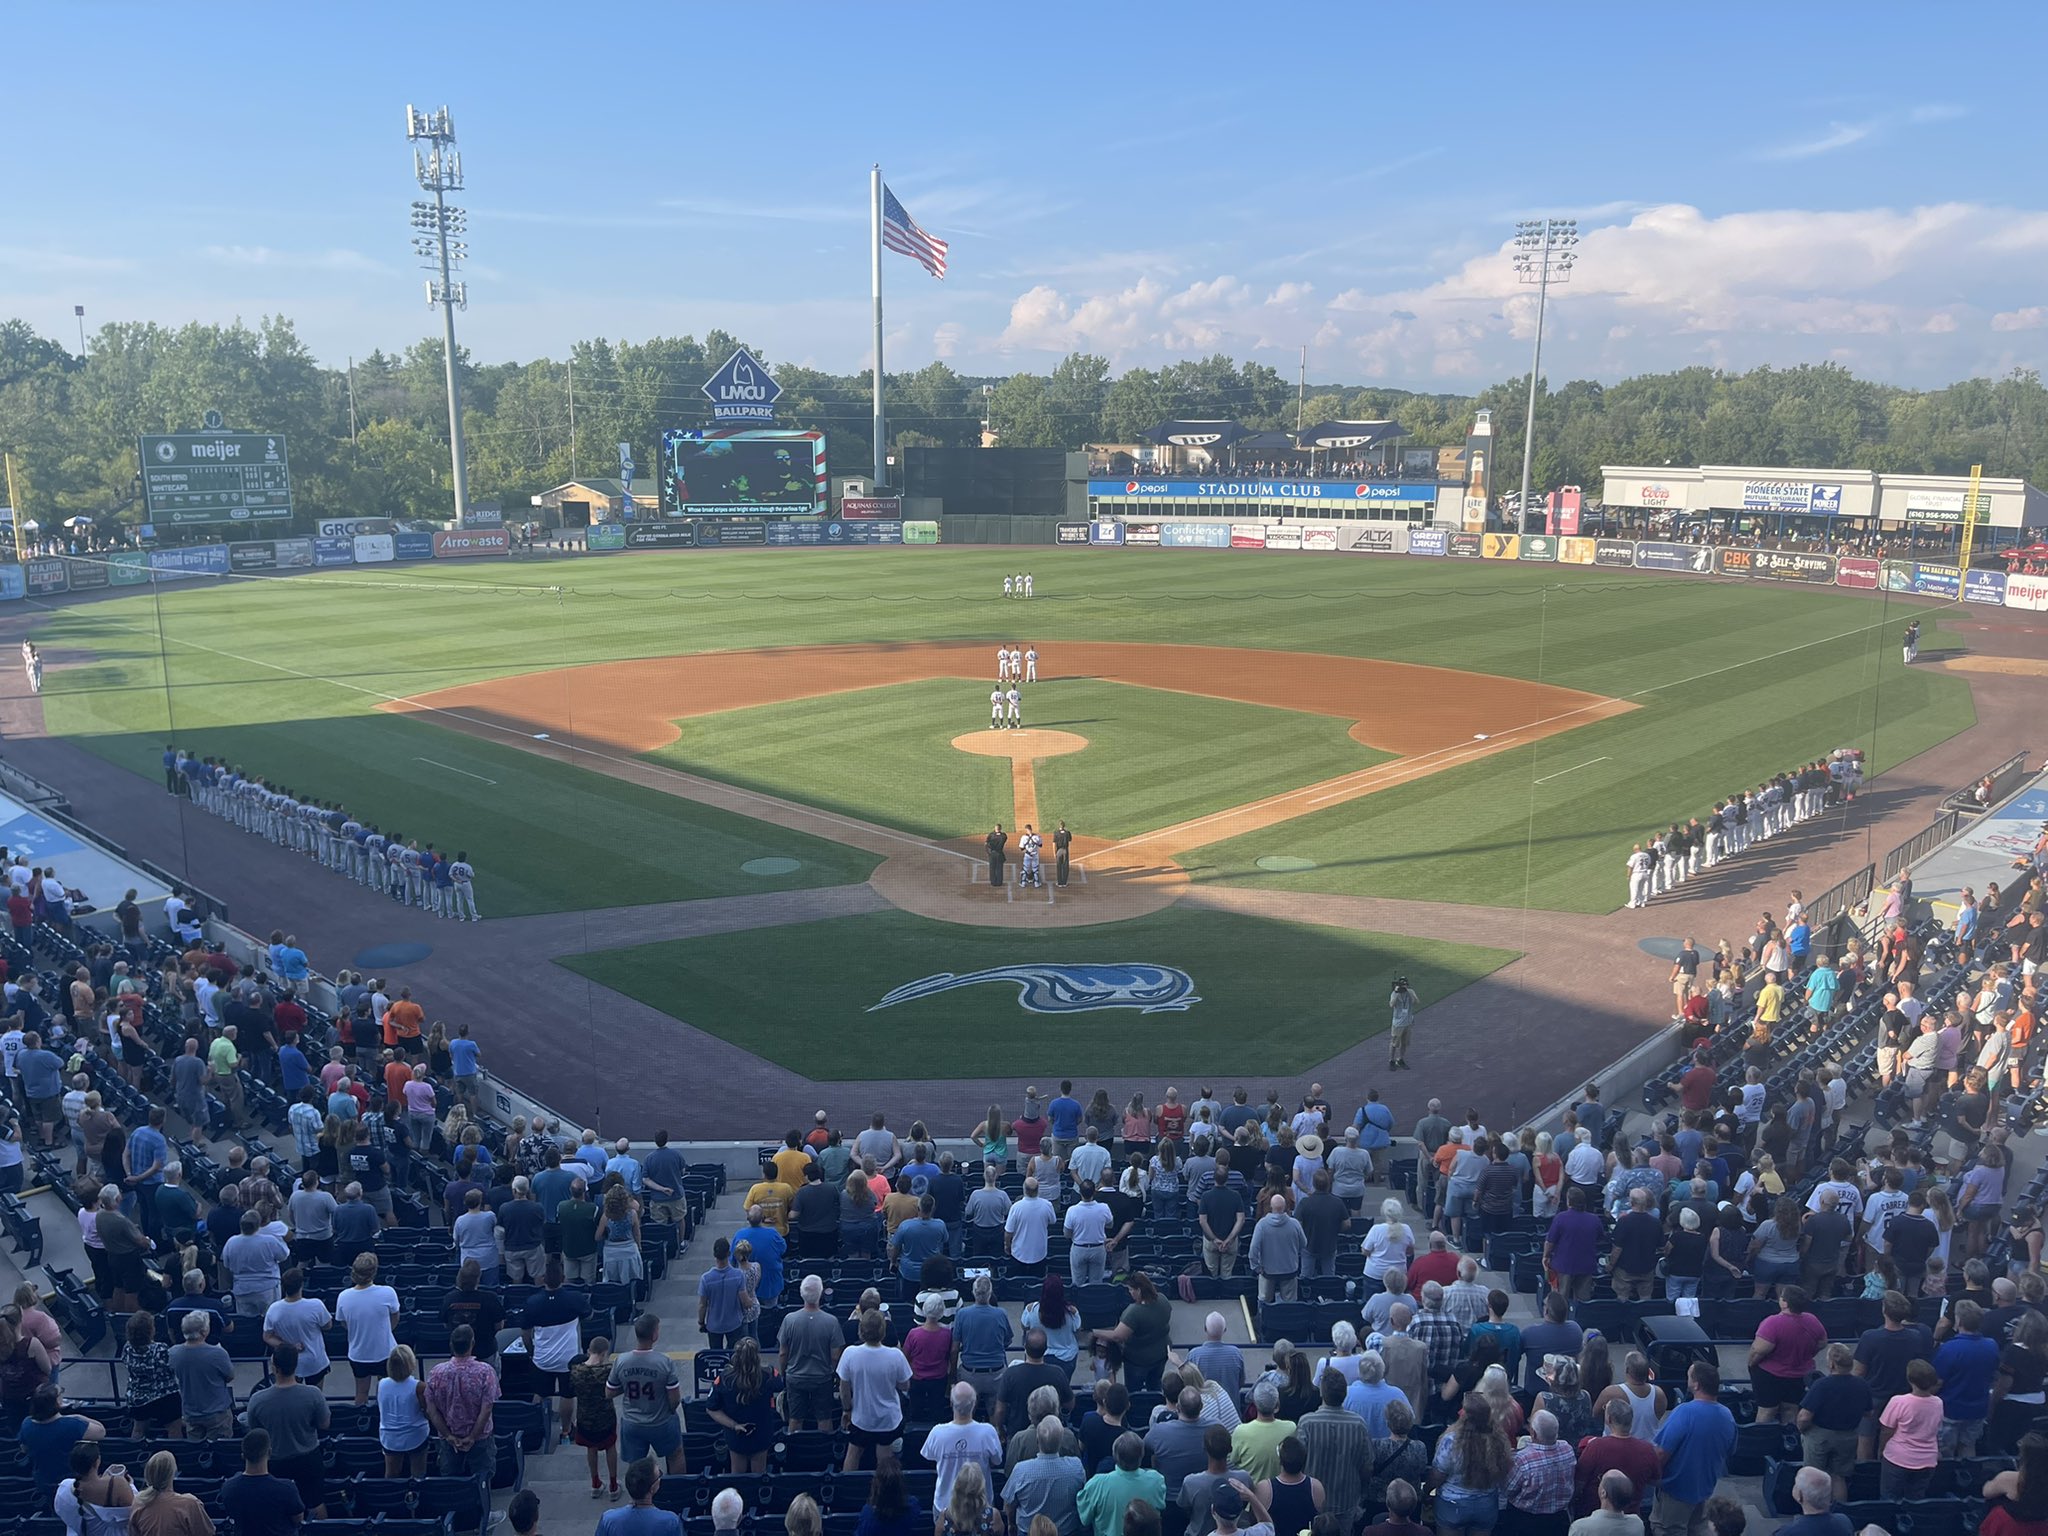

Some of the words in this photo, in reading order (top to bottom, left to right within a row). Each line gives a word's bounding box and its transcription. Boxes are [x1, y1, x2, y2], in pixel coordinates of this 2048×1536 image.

[721, 385, 766, 400] LMCU
[714, 407, 773, 418] BALLPARK
[192, 440, 241, 460] meijer
[1140, 484, 1167, 494] pepsi
[1198, 484, 1273, 495] STADIUM
[1280, 484, 1320, 496] CLUB
[1371, 487, 1400, 497] pepsi
[1642, 486, 1670, 498] Coors
[1746, 486, 1781, 494] PIONEER
[1783, 486, 1809, 496] STATE
[1468, 499, 1482, 508] Lite
[323, 522, 364, 536] GRCC
[1163, 525, 1226, 537] Confidence.
[440, 536, 503, 548] Arrowaste
[1358, 530, 1392, 542] ALTA
[152, 552, 182, 568] Behind
[184, 552, 207, 565] every
[1724, 551, 1750, 565] CBK
[29, 562, 62, 573] MAJOR
[30, 572, 62, 584] FUN
[117, 568, 141, 580] Clips
[1946, 586, 1958, 594] Spas
[2008, 584, 2048, 601] meijer
[405, 854, 410, 863] 5
[452, 867, 464, 876] 28
[5, 1043, 17, 1051] 29
[623, 1367, 658, 1378] CHAMPIONS
[628, 1380, 655, 1400] 84
